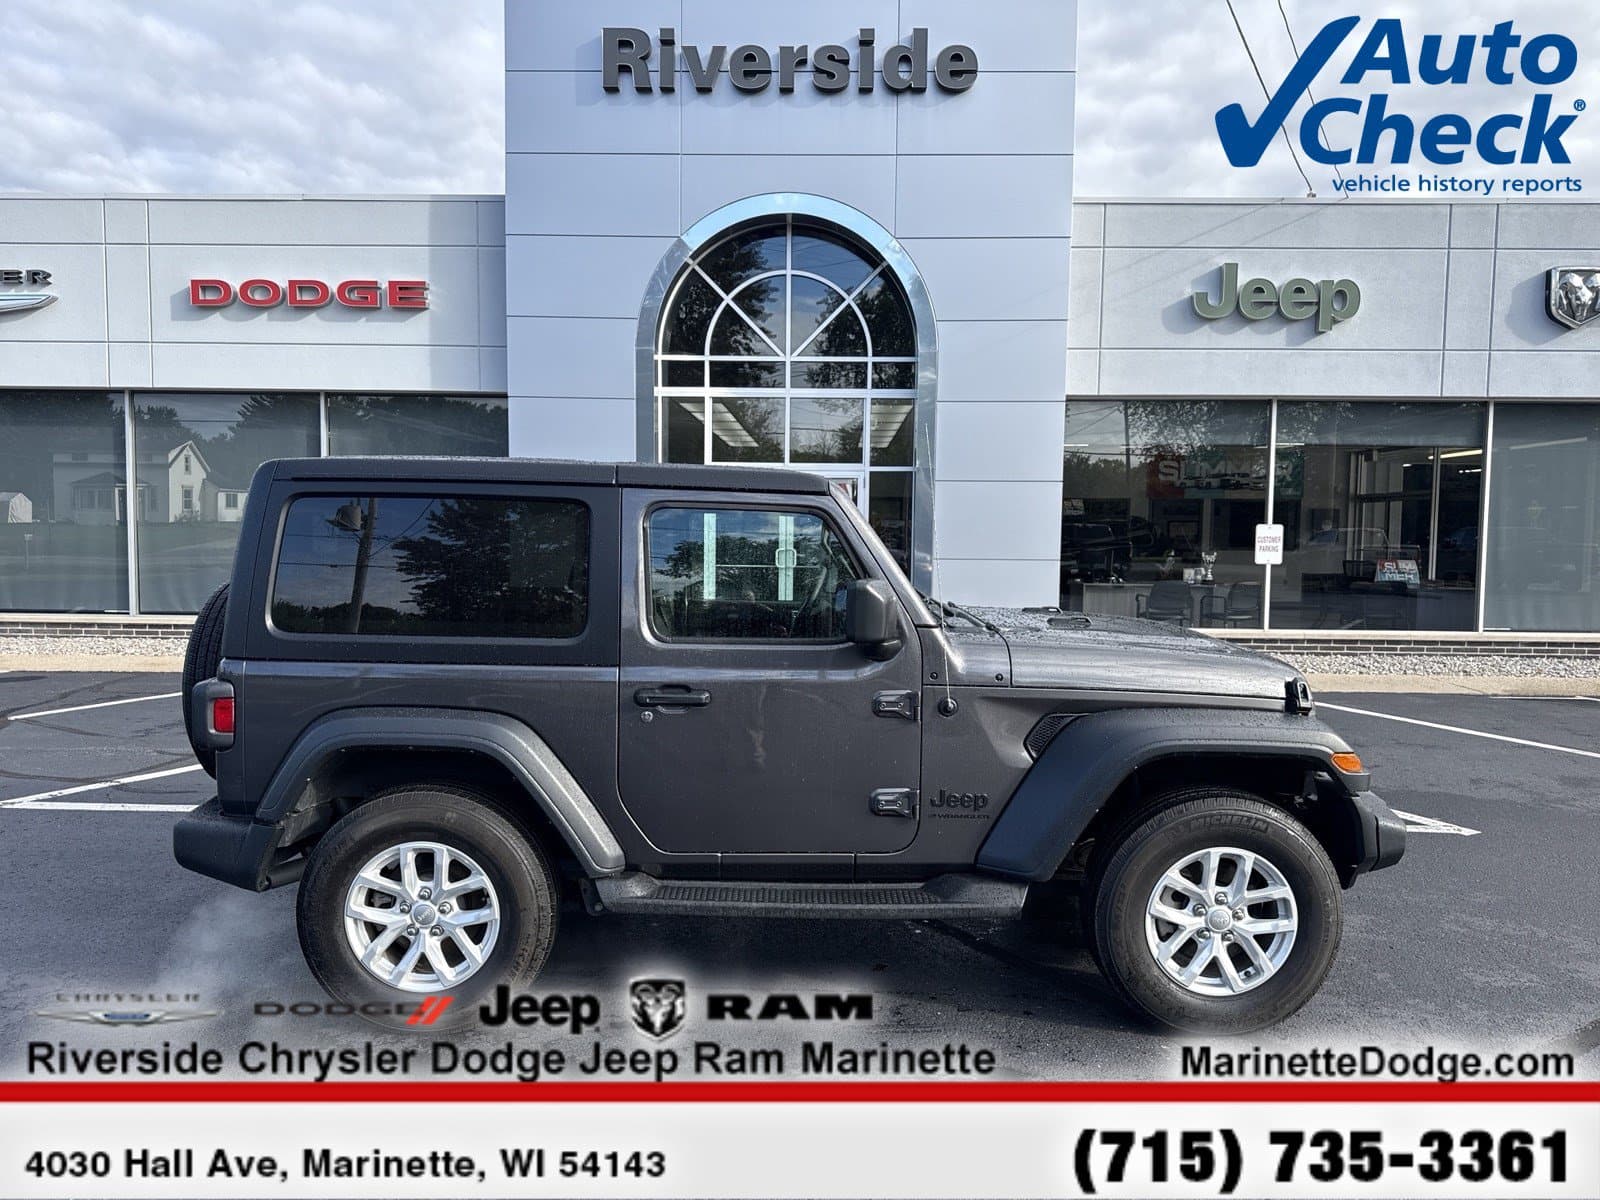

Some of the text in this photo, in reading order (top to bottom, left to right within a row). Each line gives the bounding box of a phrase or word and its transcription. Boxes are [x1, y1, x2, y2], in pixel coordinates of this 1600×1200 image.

[601, 26, 979, 94] Riverside
[190, 278, 430, 310] DODGE
[1192, 262, 1361, 333] Jeep
[1258, 545, 1279, 553] PARKING
[928, 789, 989, 812] Jeep
